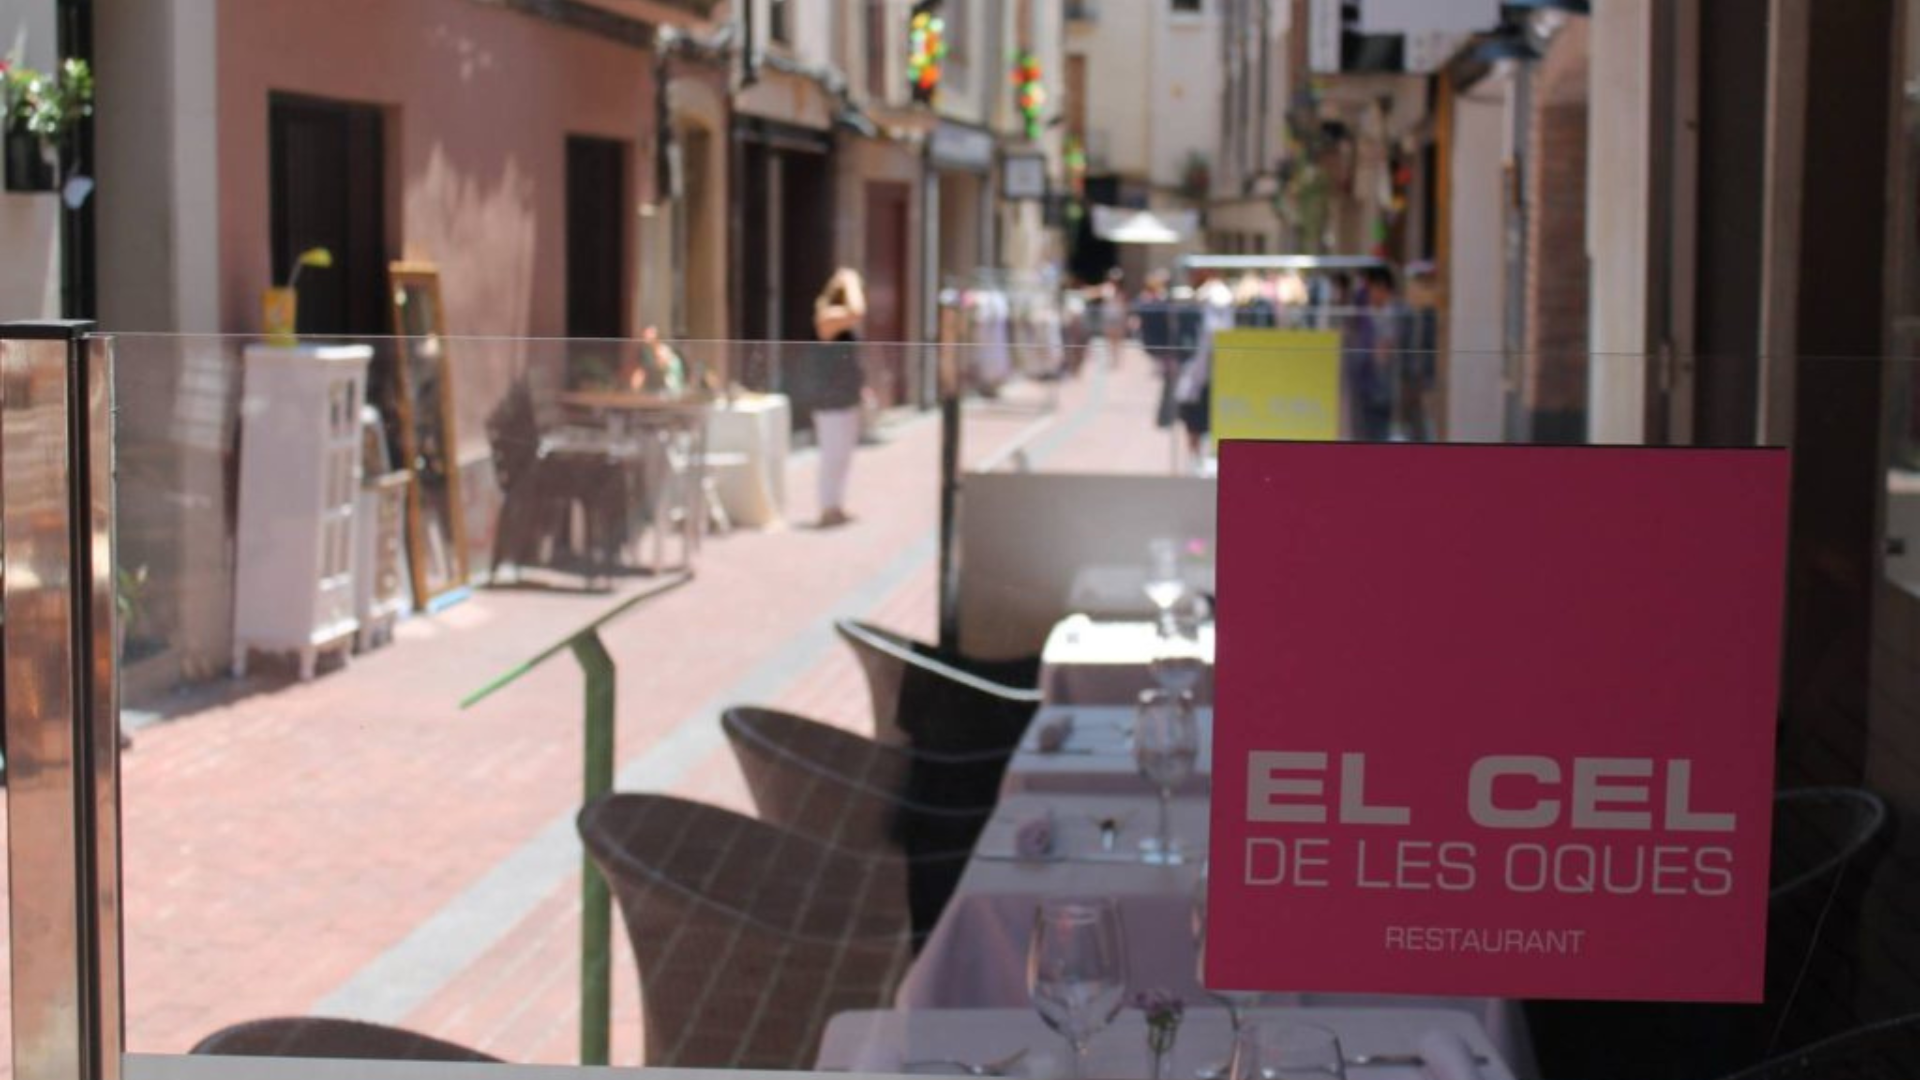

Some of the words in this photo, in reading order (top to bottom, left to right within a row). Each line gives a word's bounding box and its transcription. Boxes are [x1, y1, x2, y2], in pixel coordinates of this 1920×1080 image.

[1246, 751, 1410, 825] EL
[1468, 755, 1737, 831] CEL
[1244, 837, 1330, 887] DE
[1356, 839, 1477, 892] LES
[1504, 843, 1734, 896] OQUES
[1385, 926, 1585, 953] RESTAURANT
